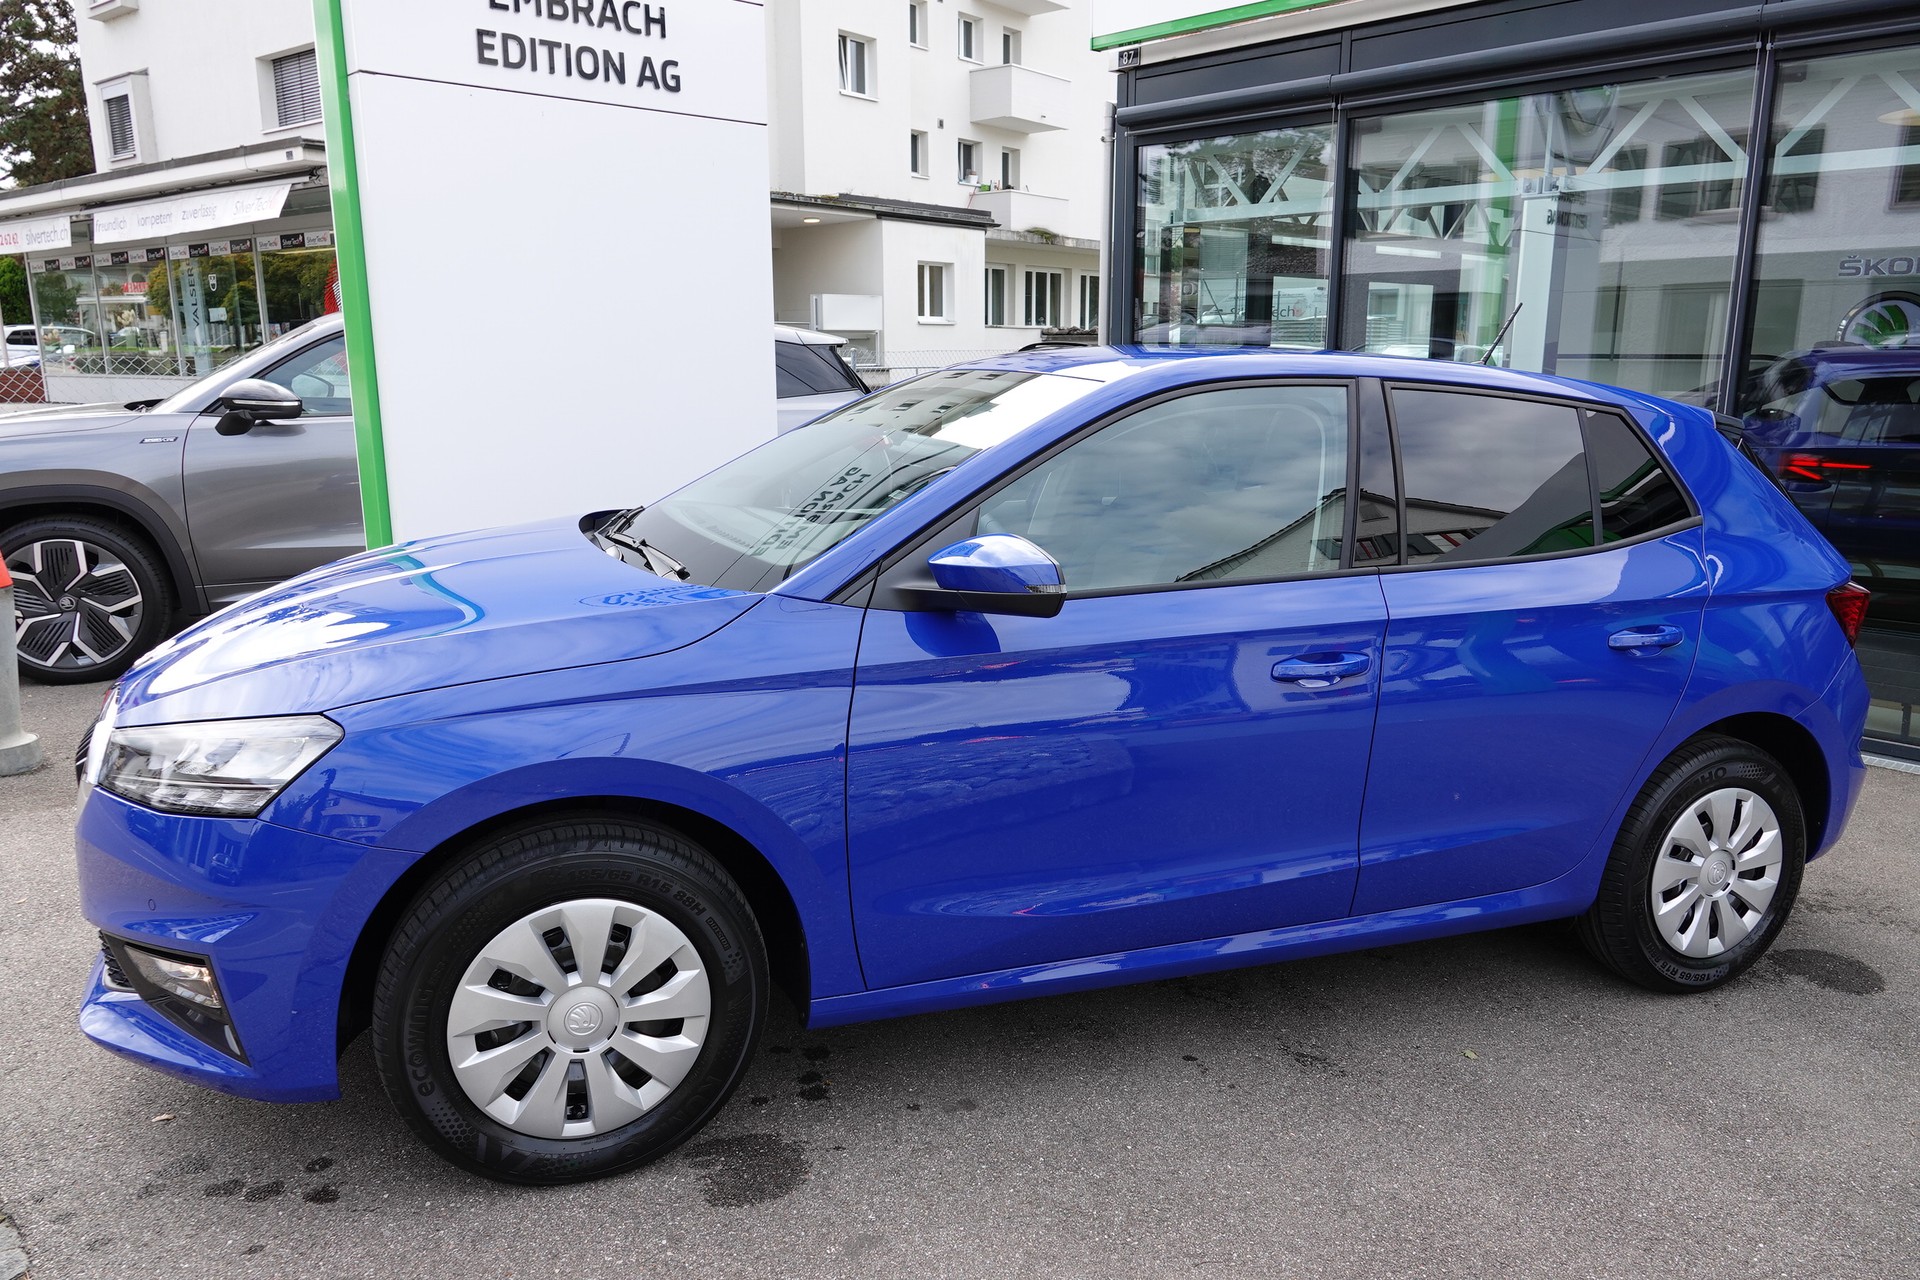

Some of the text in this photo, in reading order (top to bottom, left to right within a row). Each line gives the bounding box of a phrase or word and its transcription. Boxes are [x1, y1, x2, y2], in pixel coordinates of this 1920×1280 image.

[489, 0, 666, 39] BRACH
[476, 28, 681, 93] EDITION AG
[1122, 50, 1135, 65] 87
[1838, 253, 1920, 277] ŠKO
[636, 872, 675, 895] R15
[672, 888, 708, 917] 88H
